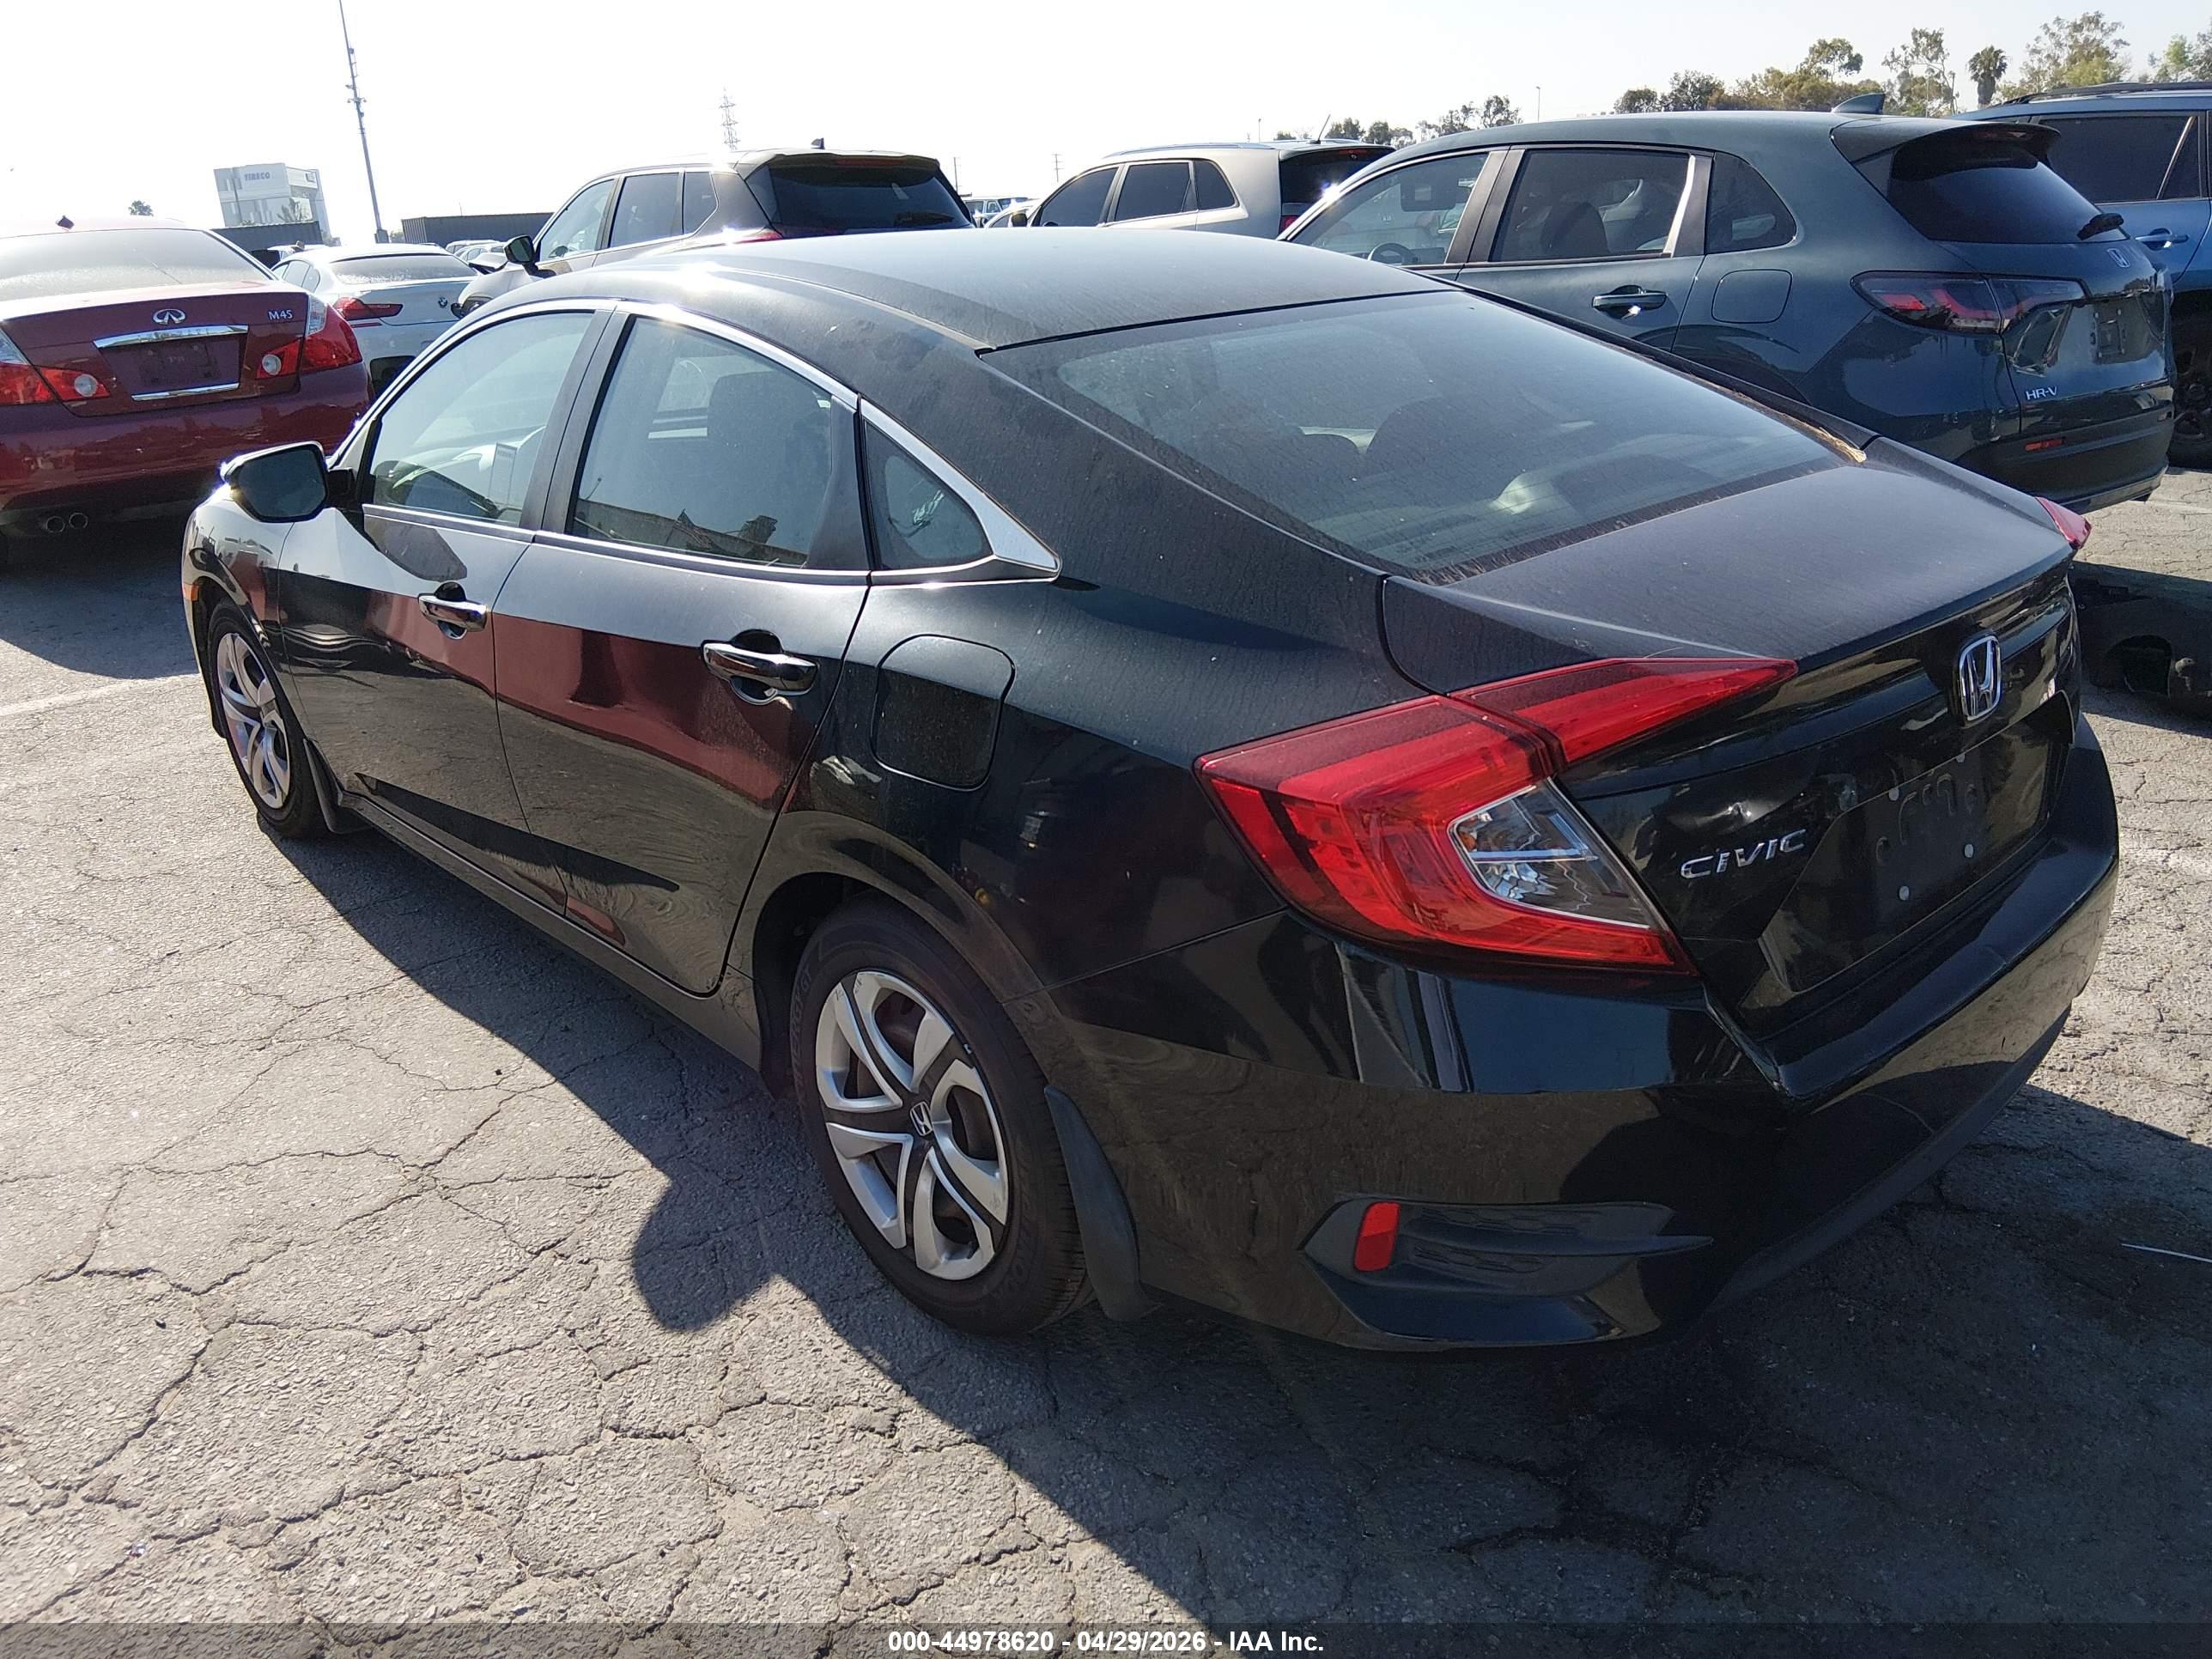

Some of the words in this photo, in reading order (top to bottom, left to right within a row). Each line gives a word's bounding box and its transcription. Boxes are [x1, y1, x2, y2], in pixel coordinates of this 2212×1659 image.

[268, 309, 293, 320] M45
[2026, 386, 2057, 400] HR-V
[1680, 829, 1806, 878] CIVIC
